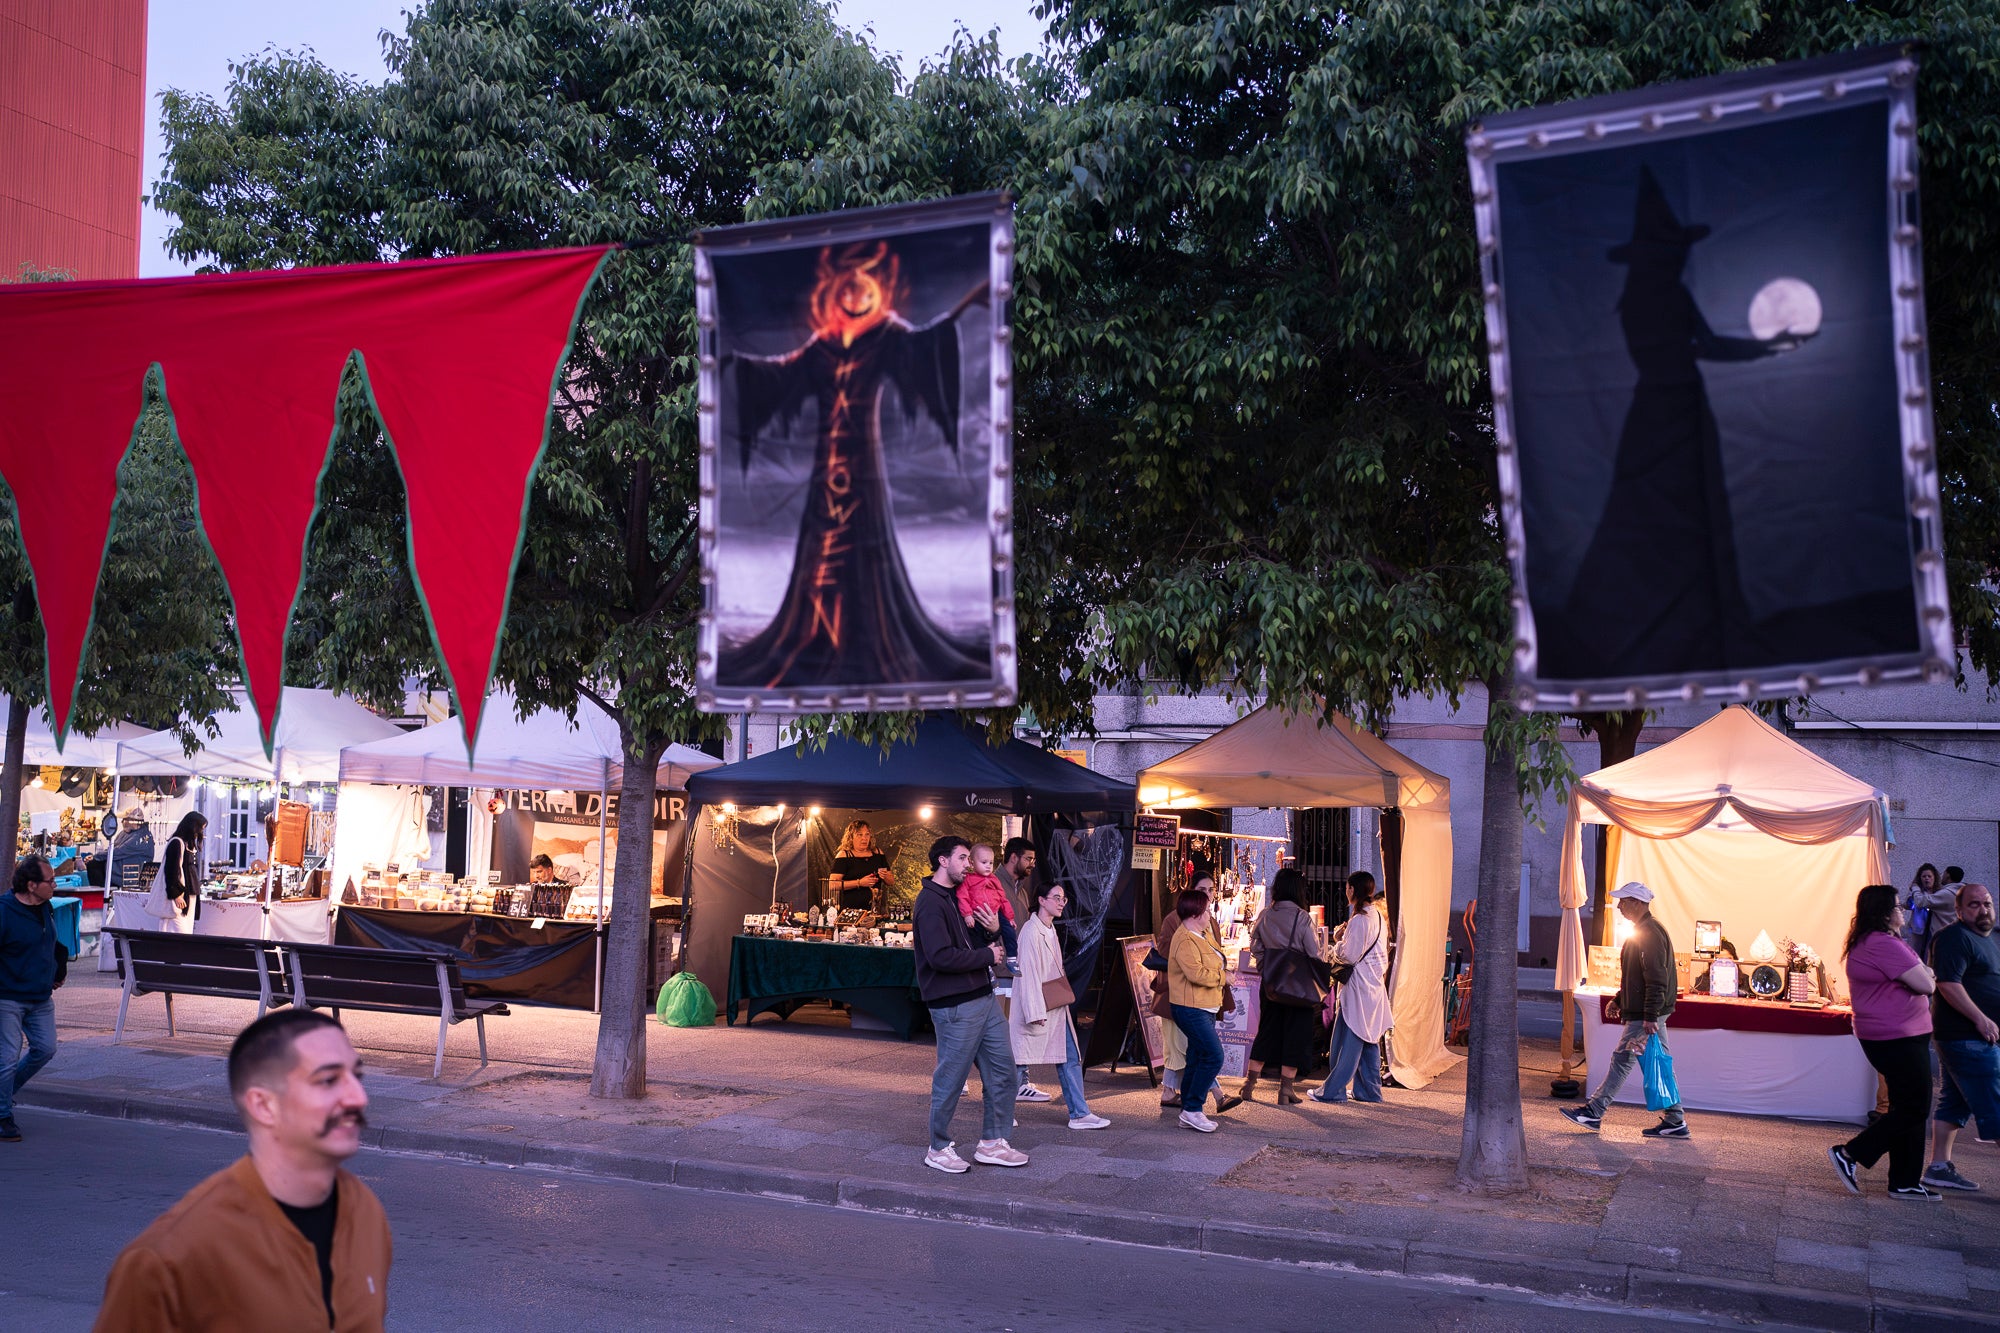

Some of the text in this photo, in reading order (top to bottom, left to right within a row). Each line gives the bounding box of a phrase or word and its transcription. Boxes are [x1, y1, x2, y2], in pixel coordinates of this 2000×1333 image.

[810, 357, 861, 650] HALLOWEEN
[584, 794, 619, 817] DE
[554, 816, 585, 825] MASSANES
[598, 819, 616, 827] SLVA
